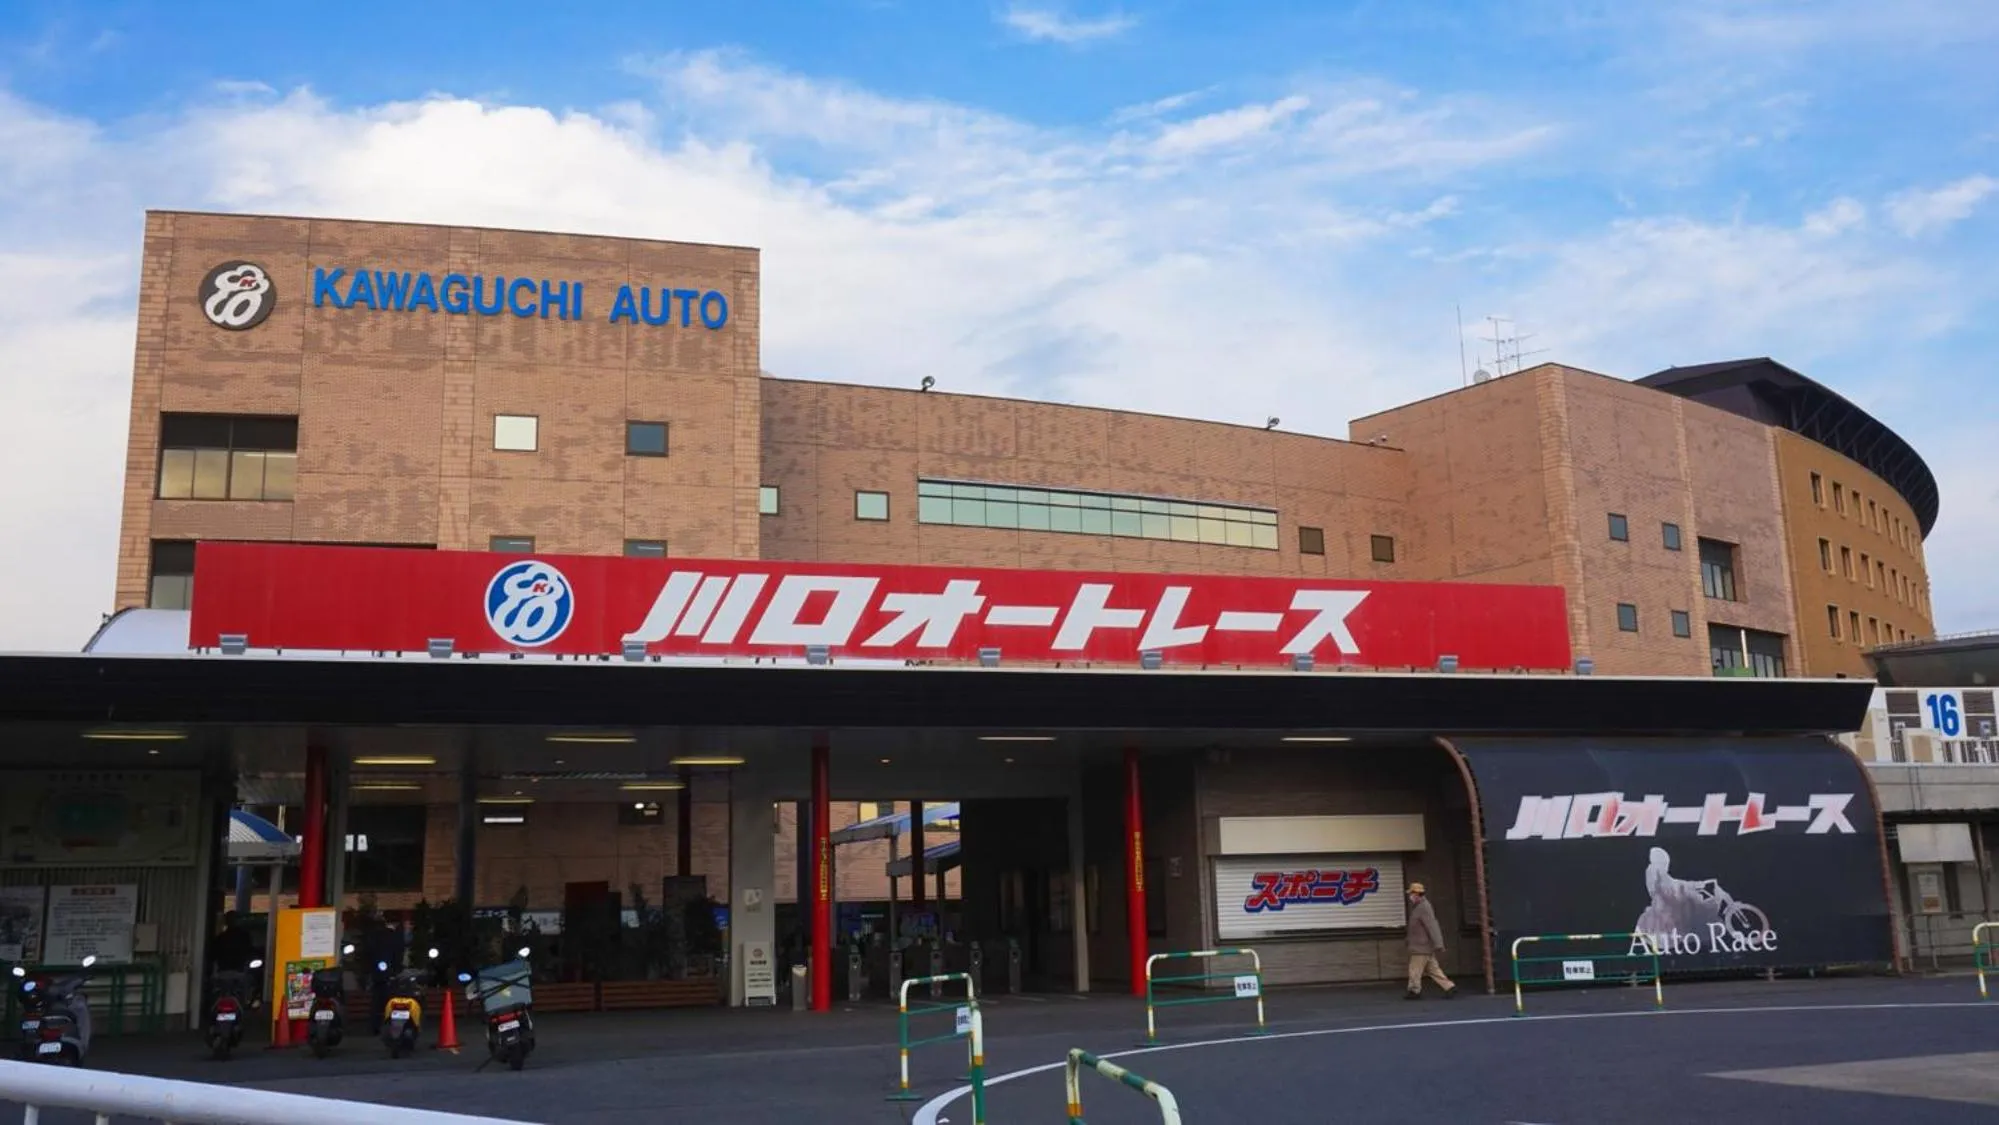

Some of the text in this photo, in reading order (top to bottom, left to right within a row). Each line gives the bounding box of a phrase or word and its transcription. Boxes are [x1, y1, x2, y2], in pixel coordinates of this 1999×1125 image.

[313, 267, 728, 330] KAWAGUCHI AUTO
[621, 571, 1371, 654] 川口オートレース
[1926, 693, 1960, 737] 16
[1506, 792, 1856, 840] 川口オートレース
[1244, 867, 1379, 912] スポニチ
[1627, 921, 1778, 957] Auto Race
